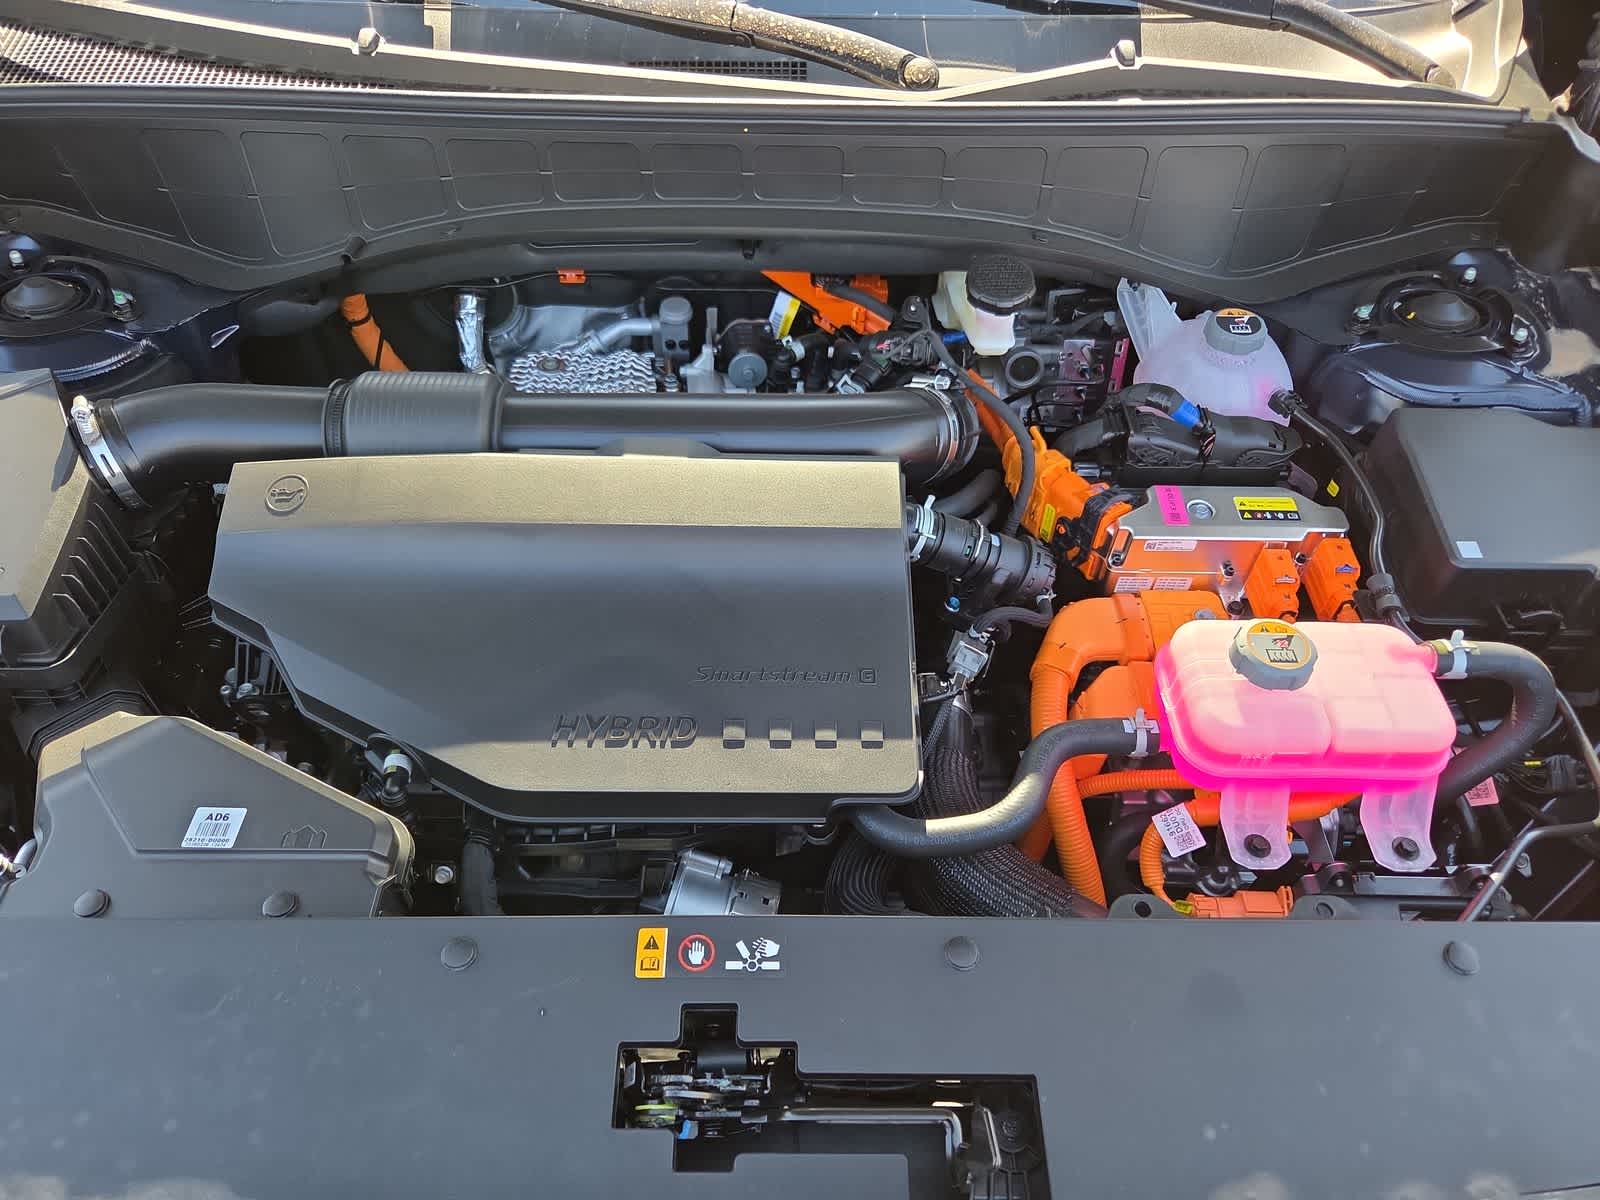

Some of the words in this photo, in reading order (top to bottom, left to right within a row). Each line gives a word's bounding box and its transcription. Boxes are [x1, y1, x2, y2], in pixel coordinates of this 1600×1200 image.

[695, 665, 851, 683] Smartstream
[551, 713, 698, 749] HYBRID
[205, 813, 230, 822] AD6
